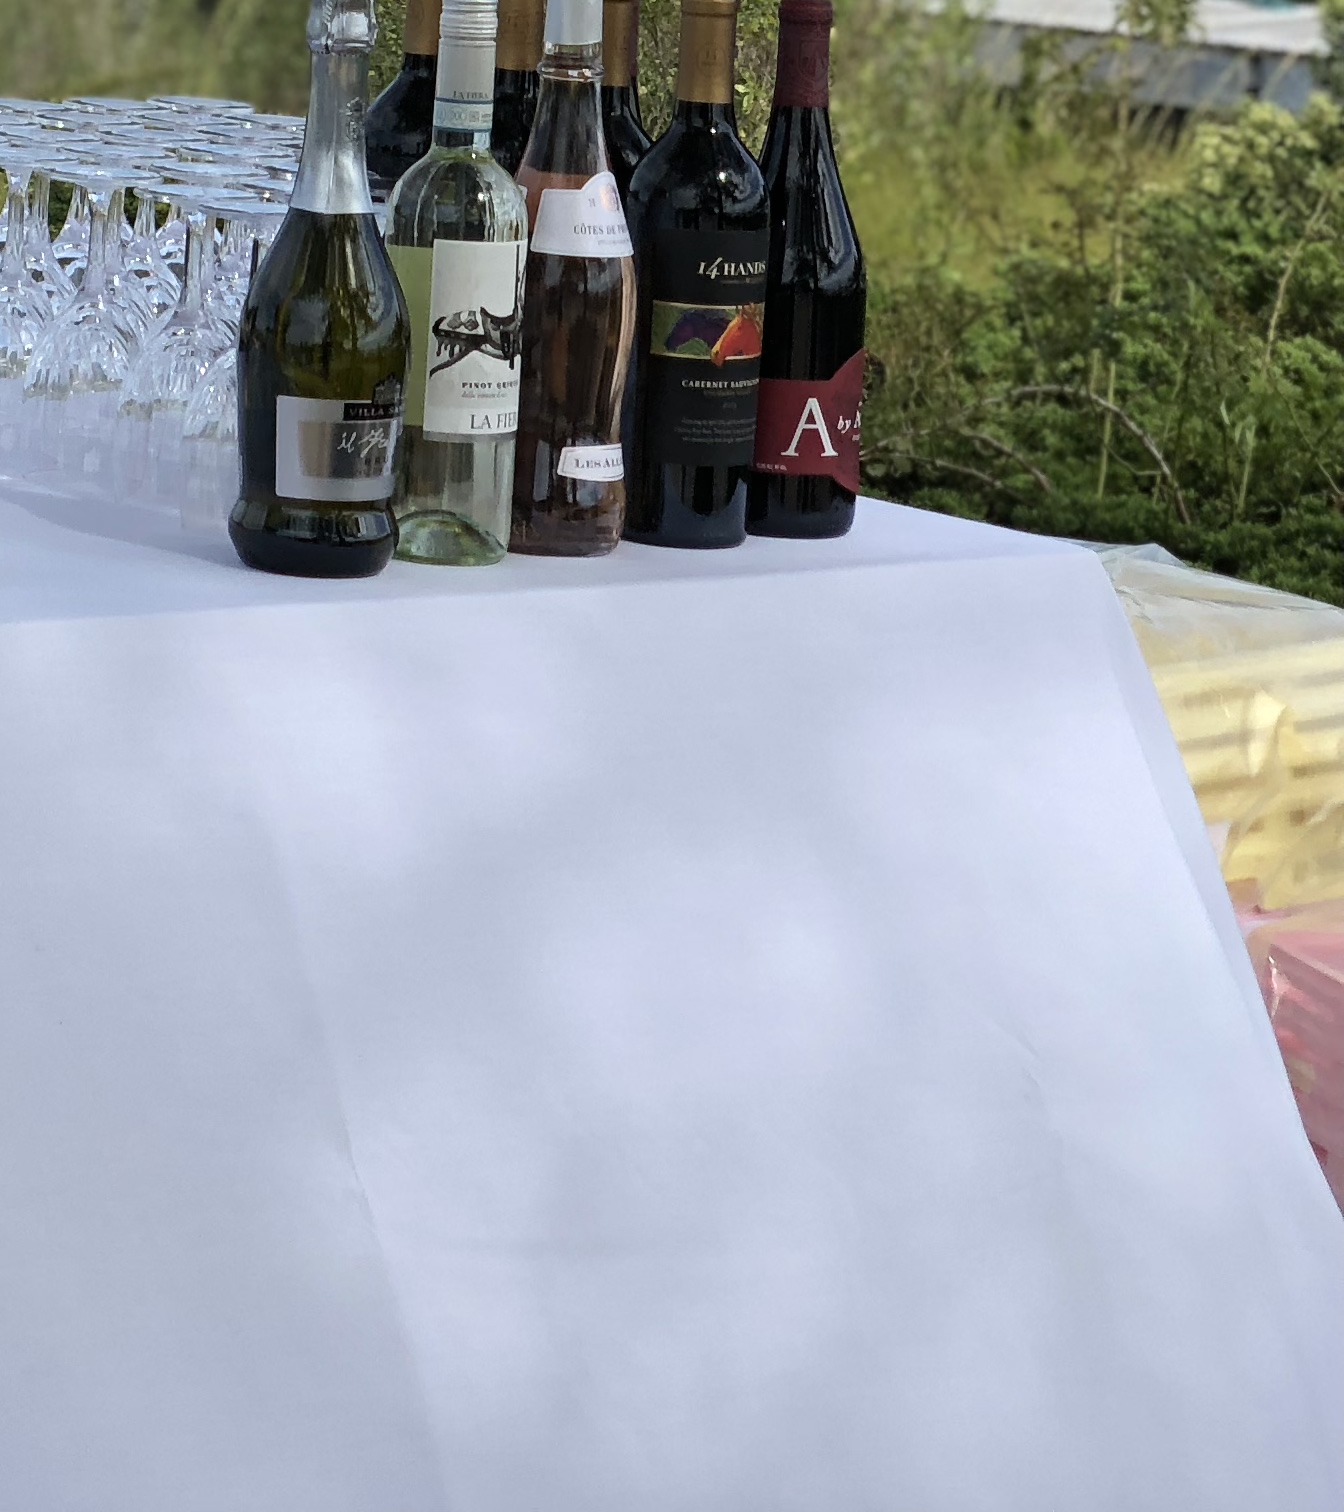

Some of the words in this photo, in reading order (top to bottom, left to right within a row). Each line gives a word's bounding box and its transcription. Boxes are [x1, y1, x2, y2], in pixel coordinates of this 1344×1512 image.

[573, 223, 604, 235] CÔTES
[696, 256, 723, 280] 14
[723, 261, 766, 276] HANDS
[461, 381, 493, 389] PINOT
[681, 380, 729, 389] CABERNET
[349, 407, 384, 417] VILLA
[470, 414, 492, 429] LA
[781, 397, 838, 457] A
[837, 415, 852, 434] by
[574, 457, 601, 469] LES
